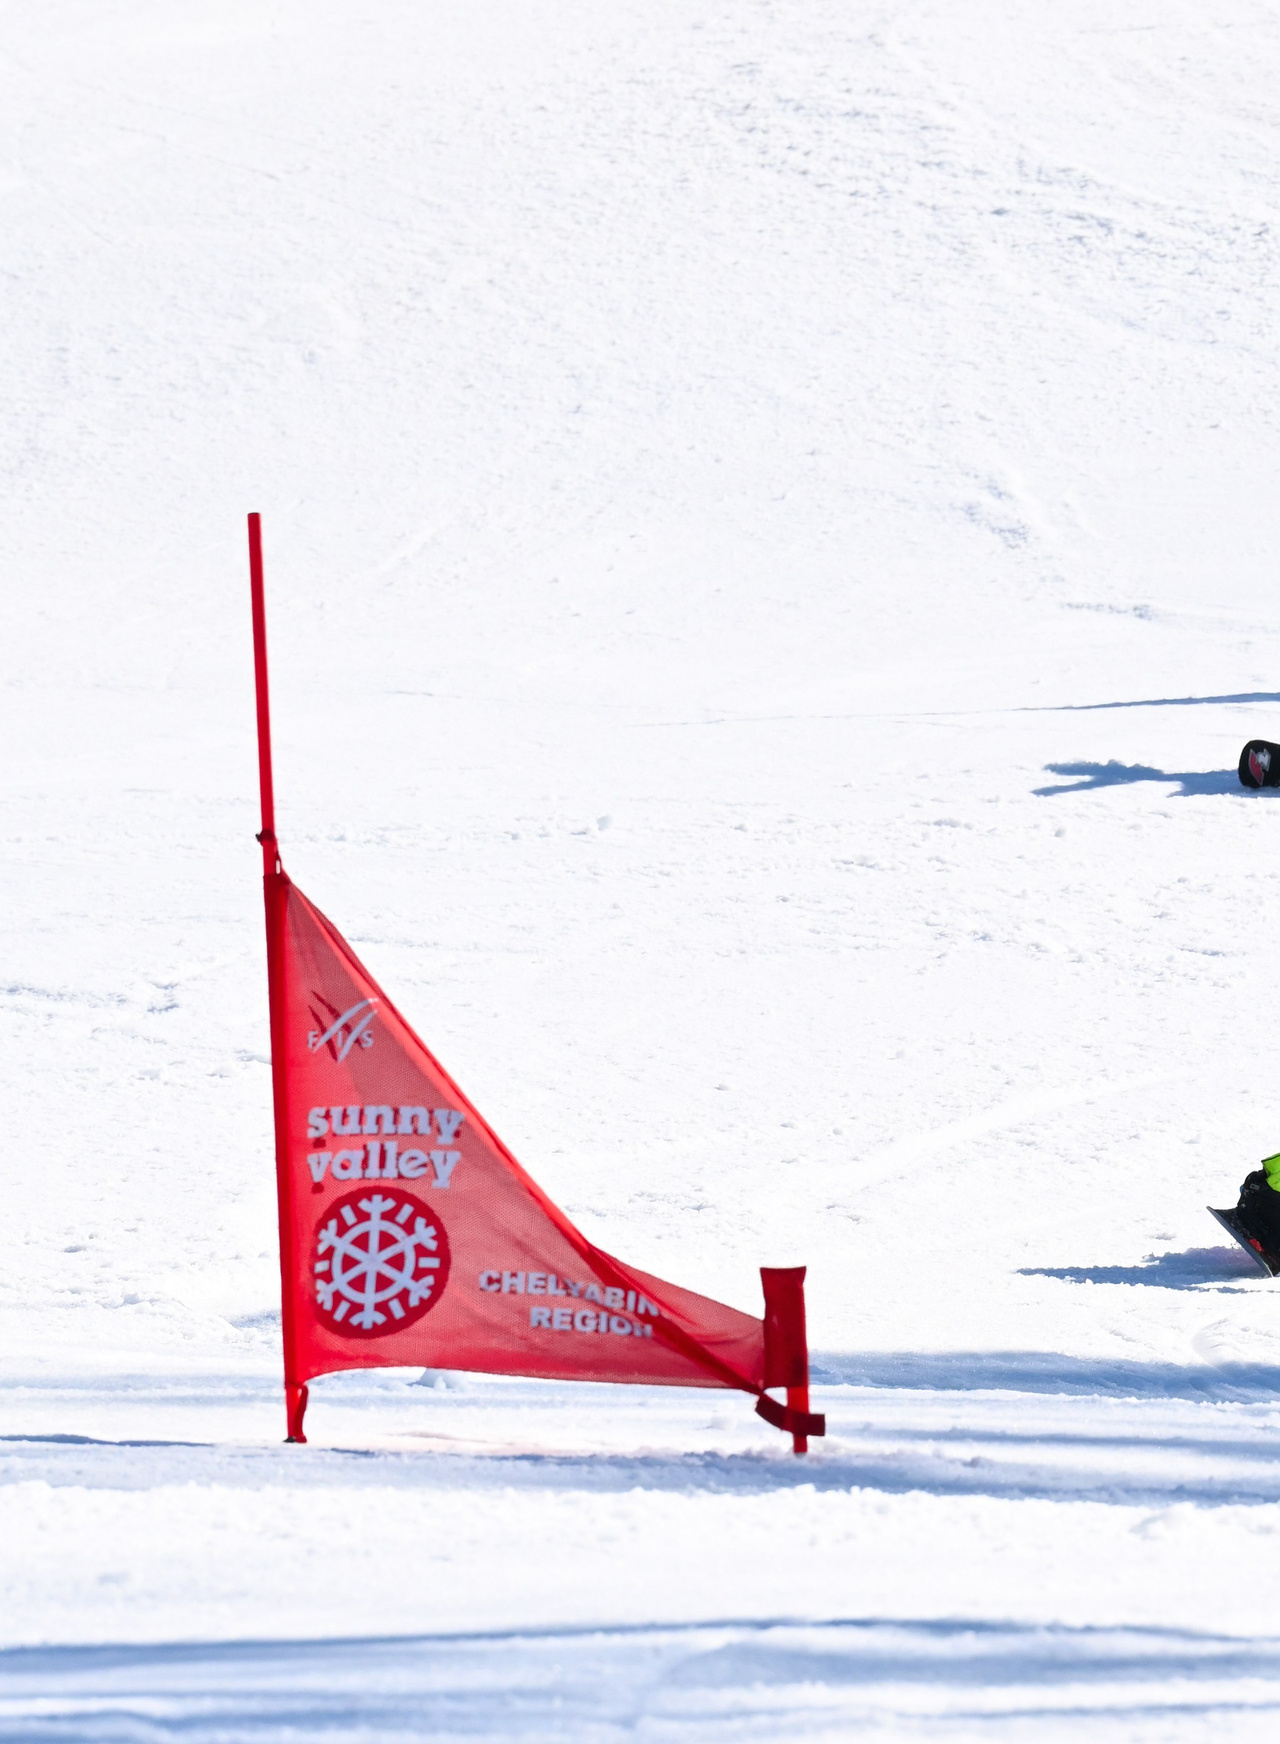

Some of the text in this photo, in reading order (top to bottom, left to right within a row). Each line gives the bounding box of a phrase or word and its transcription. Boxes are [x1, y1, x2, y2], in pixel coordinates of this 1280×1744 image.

[307, 1104, 465, 1145] sunny
[306, 1141, 461, 1189] valley
[530, 1305, 653, 1338] REGION
